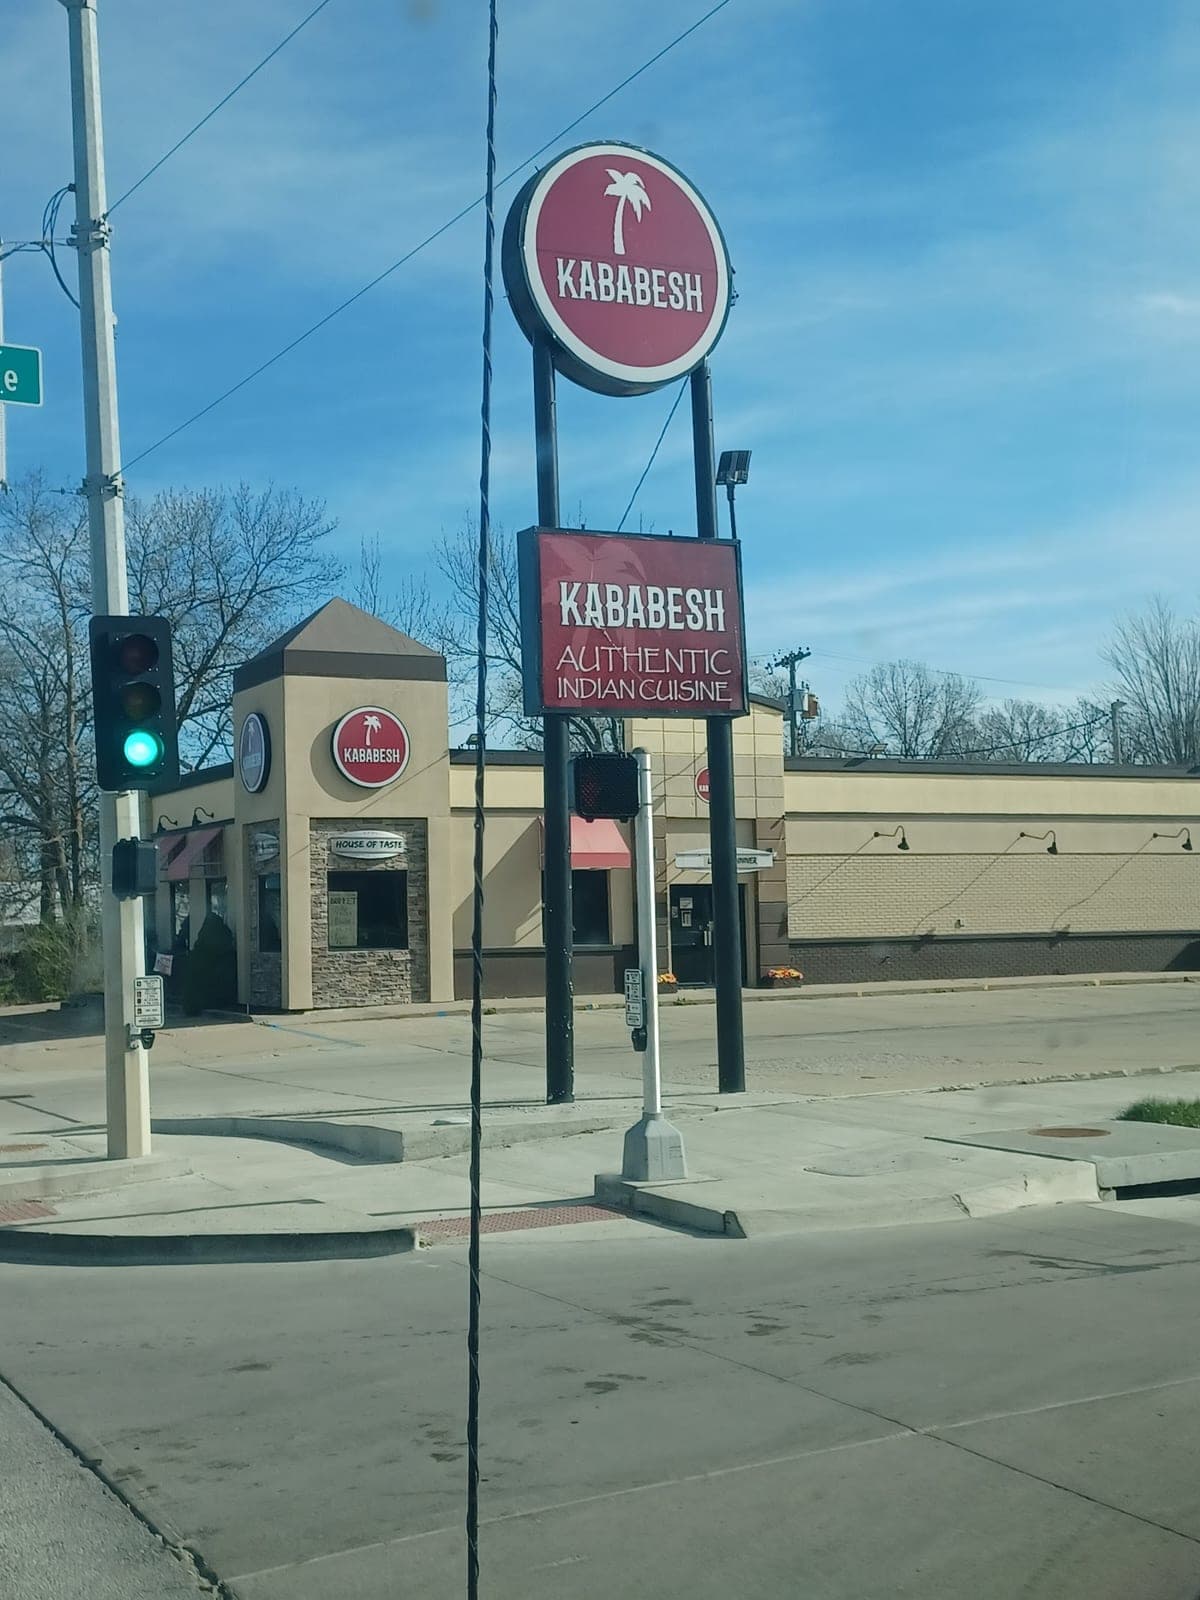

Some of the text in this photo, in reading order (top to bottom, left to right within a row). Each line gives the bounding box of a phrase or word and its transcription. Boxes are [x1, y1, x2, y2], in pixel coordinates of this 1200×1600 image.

[556, 257, 703, 313] KABABESH
[559, 581, 726, 632] KABABESH
[555, 645, 732, 675] AUTHENTIC
[557, 677, 733, 702] INDIAN CUISINE
[343, 747, 401, 763] KABABESH
[335, 840, 364, 849] HOUSE
[366, 840, 377, 849] OF
